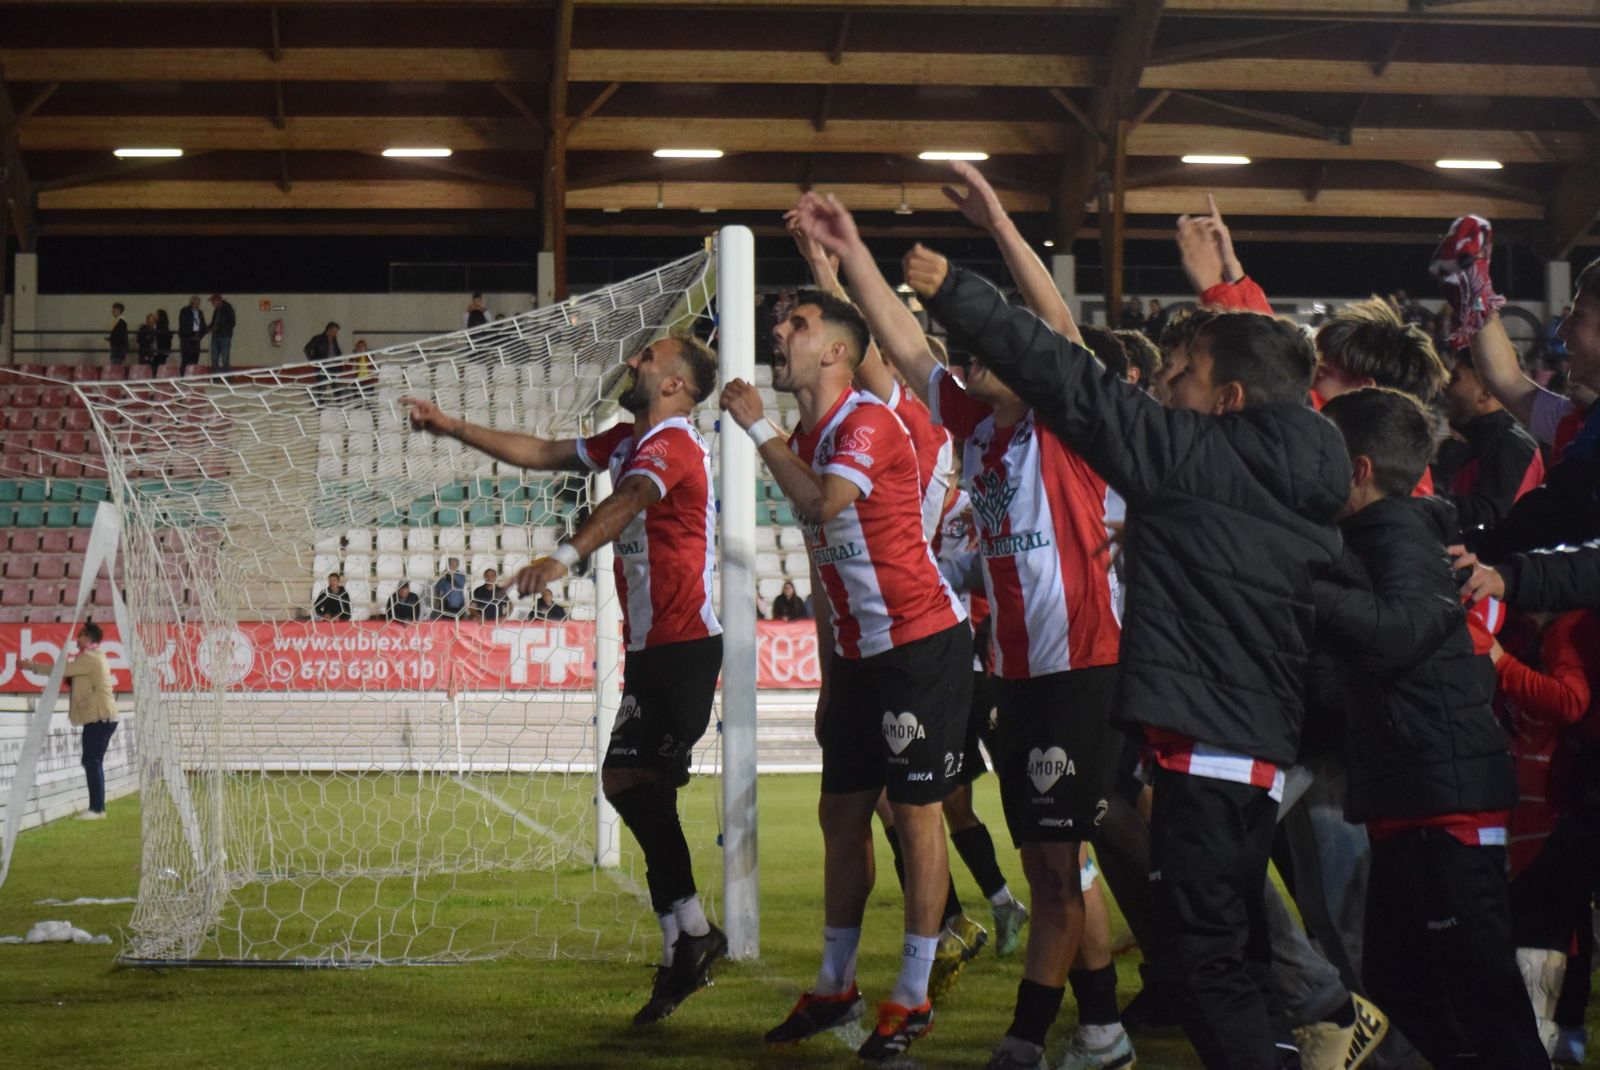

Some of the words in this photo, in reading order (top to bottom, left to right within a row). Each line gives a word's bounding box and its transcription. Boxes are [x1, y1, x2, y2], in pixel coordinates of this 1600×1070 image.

[997, 532, 1050, 556] RURAL
[273, 632, 433, 651] www.cubiex.es
[301, 659, 341, 680] 675
[347, 659, 388, 680] 630
[882, 723, 926, 740] AMORA
[1027, 759, 1076, 776] AMORA
[1344, 1001, 1381, 1070] NIKE
